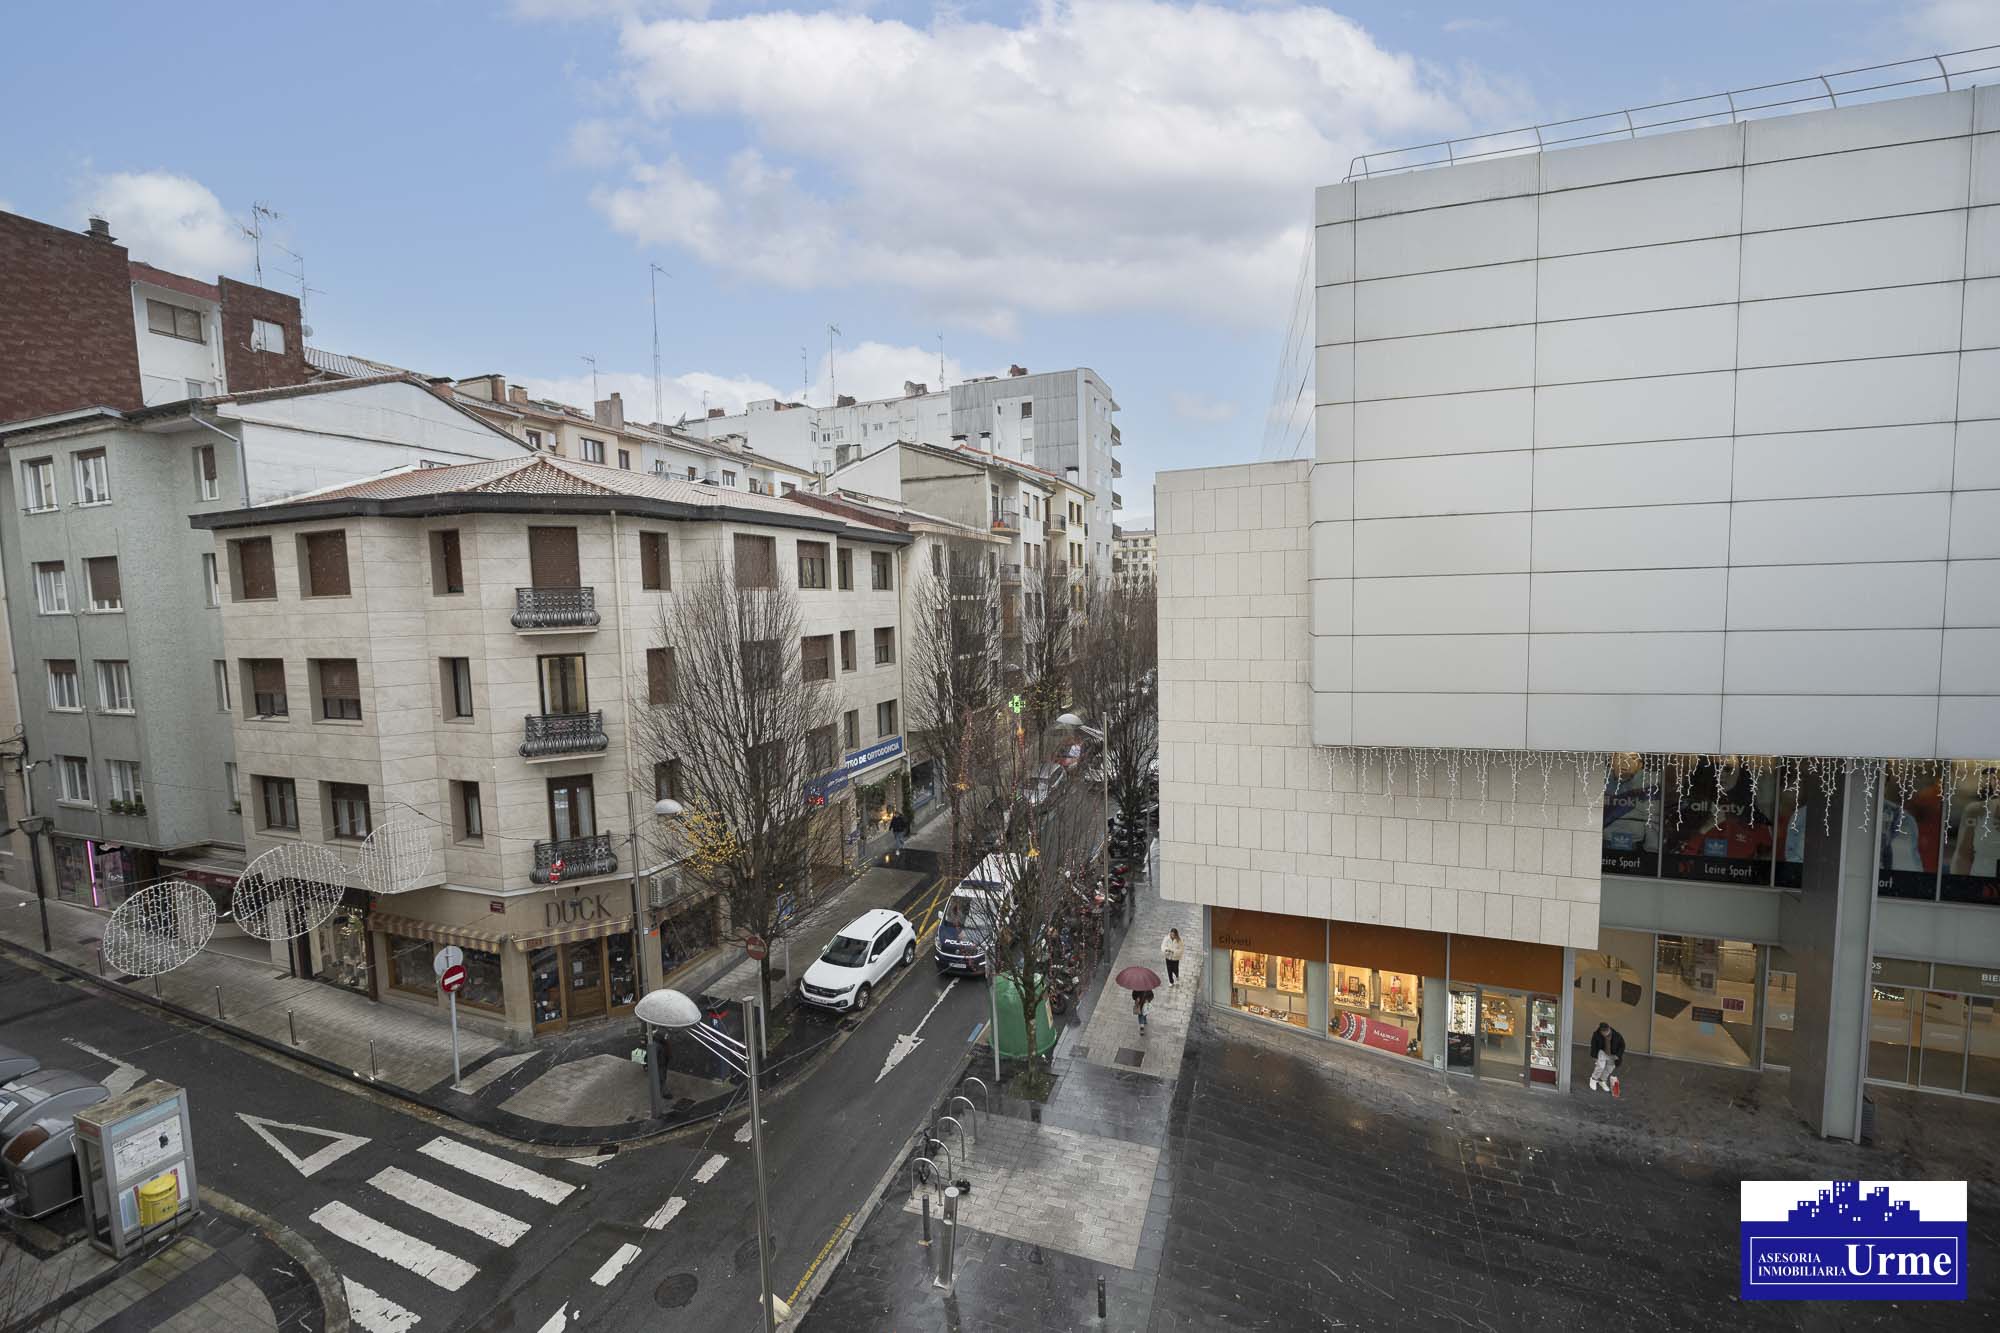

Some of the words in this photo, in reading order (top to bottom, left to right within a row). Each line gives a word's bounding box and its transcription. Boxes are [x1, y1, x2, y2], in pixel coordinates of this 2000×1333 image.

[859, 755, 866, 763] DE
[1619, 857, 1640, 870] Sport
[1705, 864, 1726, 875] Leire
[1729, 865, 1752, 877] Sport
[545, 894, 611, 927] DUCK
